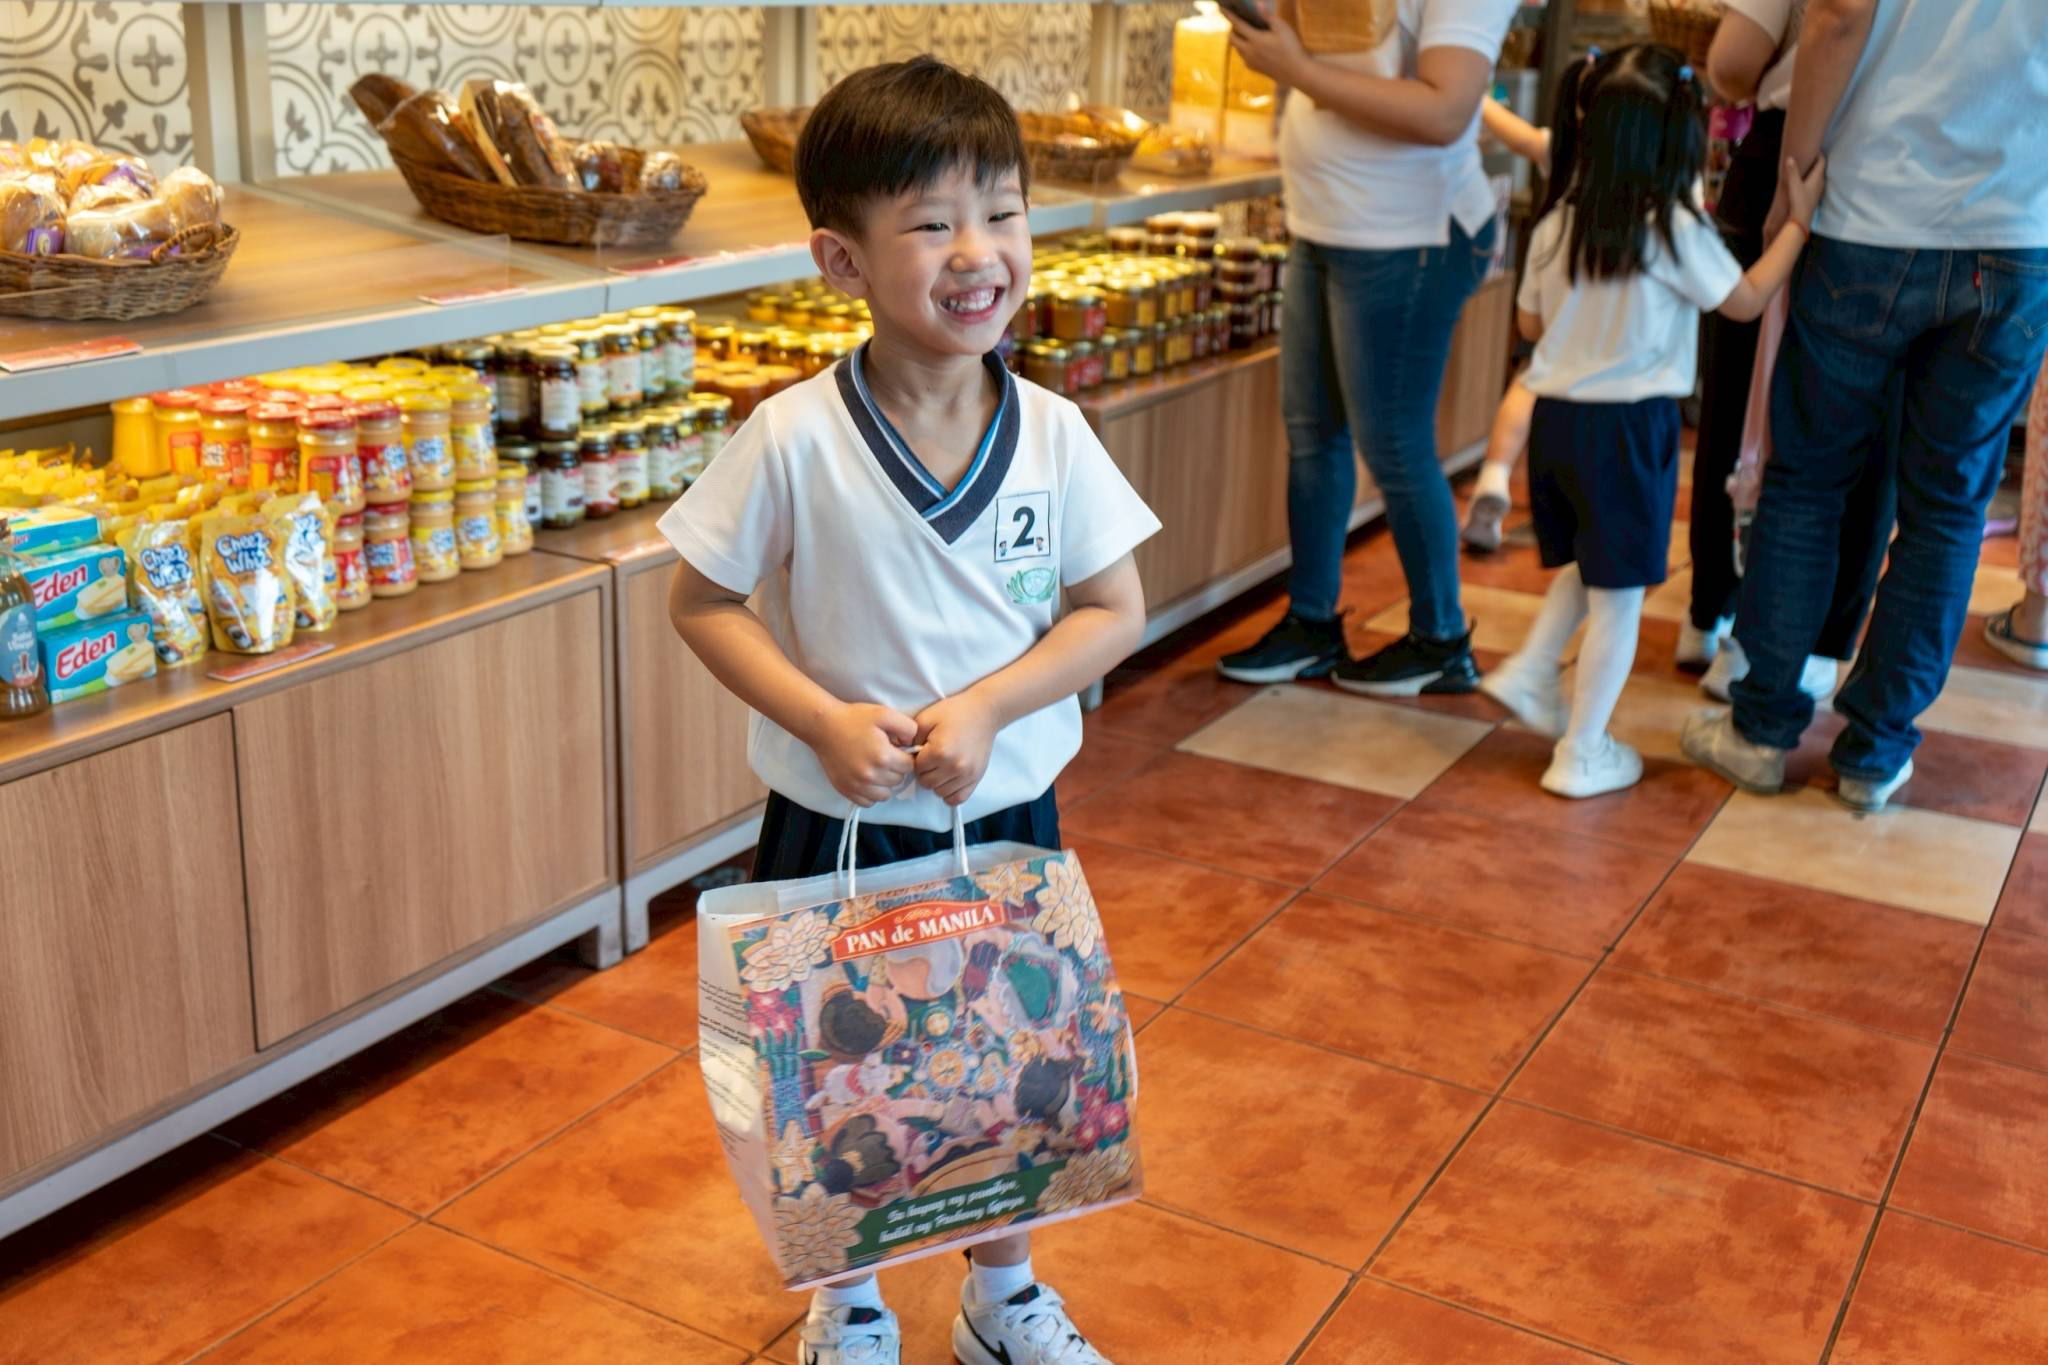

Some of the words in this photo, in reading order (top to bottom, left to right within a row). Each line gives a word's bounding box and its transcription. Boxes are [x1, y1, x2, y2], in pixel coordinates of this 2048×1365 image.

[215, 530, 271, 557] Cheez
[1012, 506, 1035, 549] 2
[141, 543, 189, 571] Cheez
[224, 548, 272, 574] Whiz
[31, 564, 88, 609] Eden
[56, 631, 116, 679] Eden
[846, 928, 887, 953] PAN
[891, 925, 914, 944] de
[918, 905, 995, 939] MANILA
